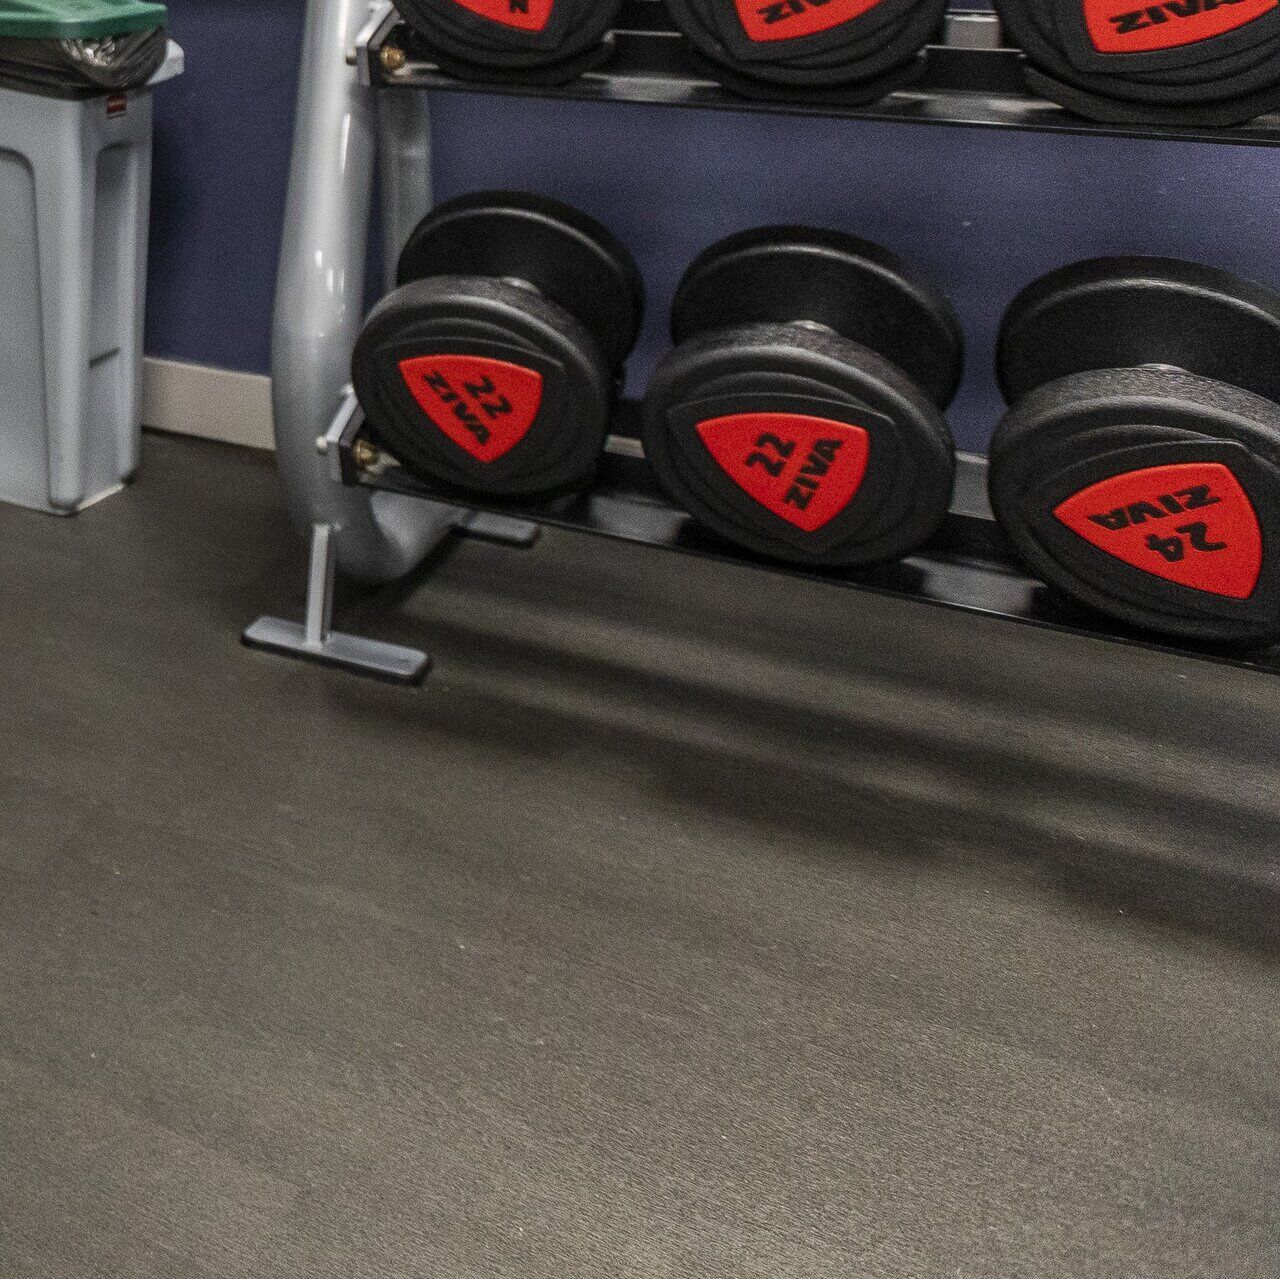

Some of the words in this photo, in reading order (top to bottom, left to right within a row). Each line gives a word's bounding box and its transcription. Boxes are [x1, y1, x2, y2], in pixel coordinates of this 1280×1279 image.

[424, 370, 492, 446] ZIVA
[464, 375, 513, 420] 22
[746, 431, 797, 478] 22
[781, 436, 845, 512] ZIVA
[1088, 484, 1222, 531] ZIVA
[1145, 521, 1228, 563] 24
